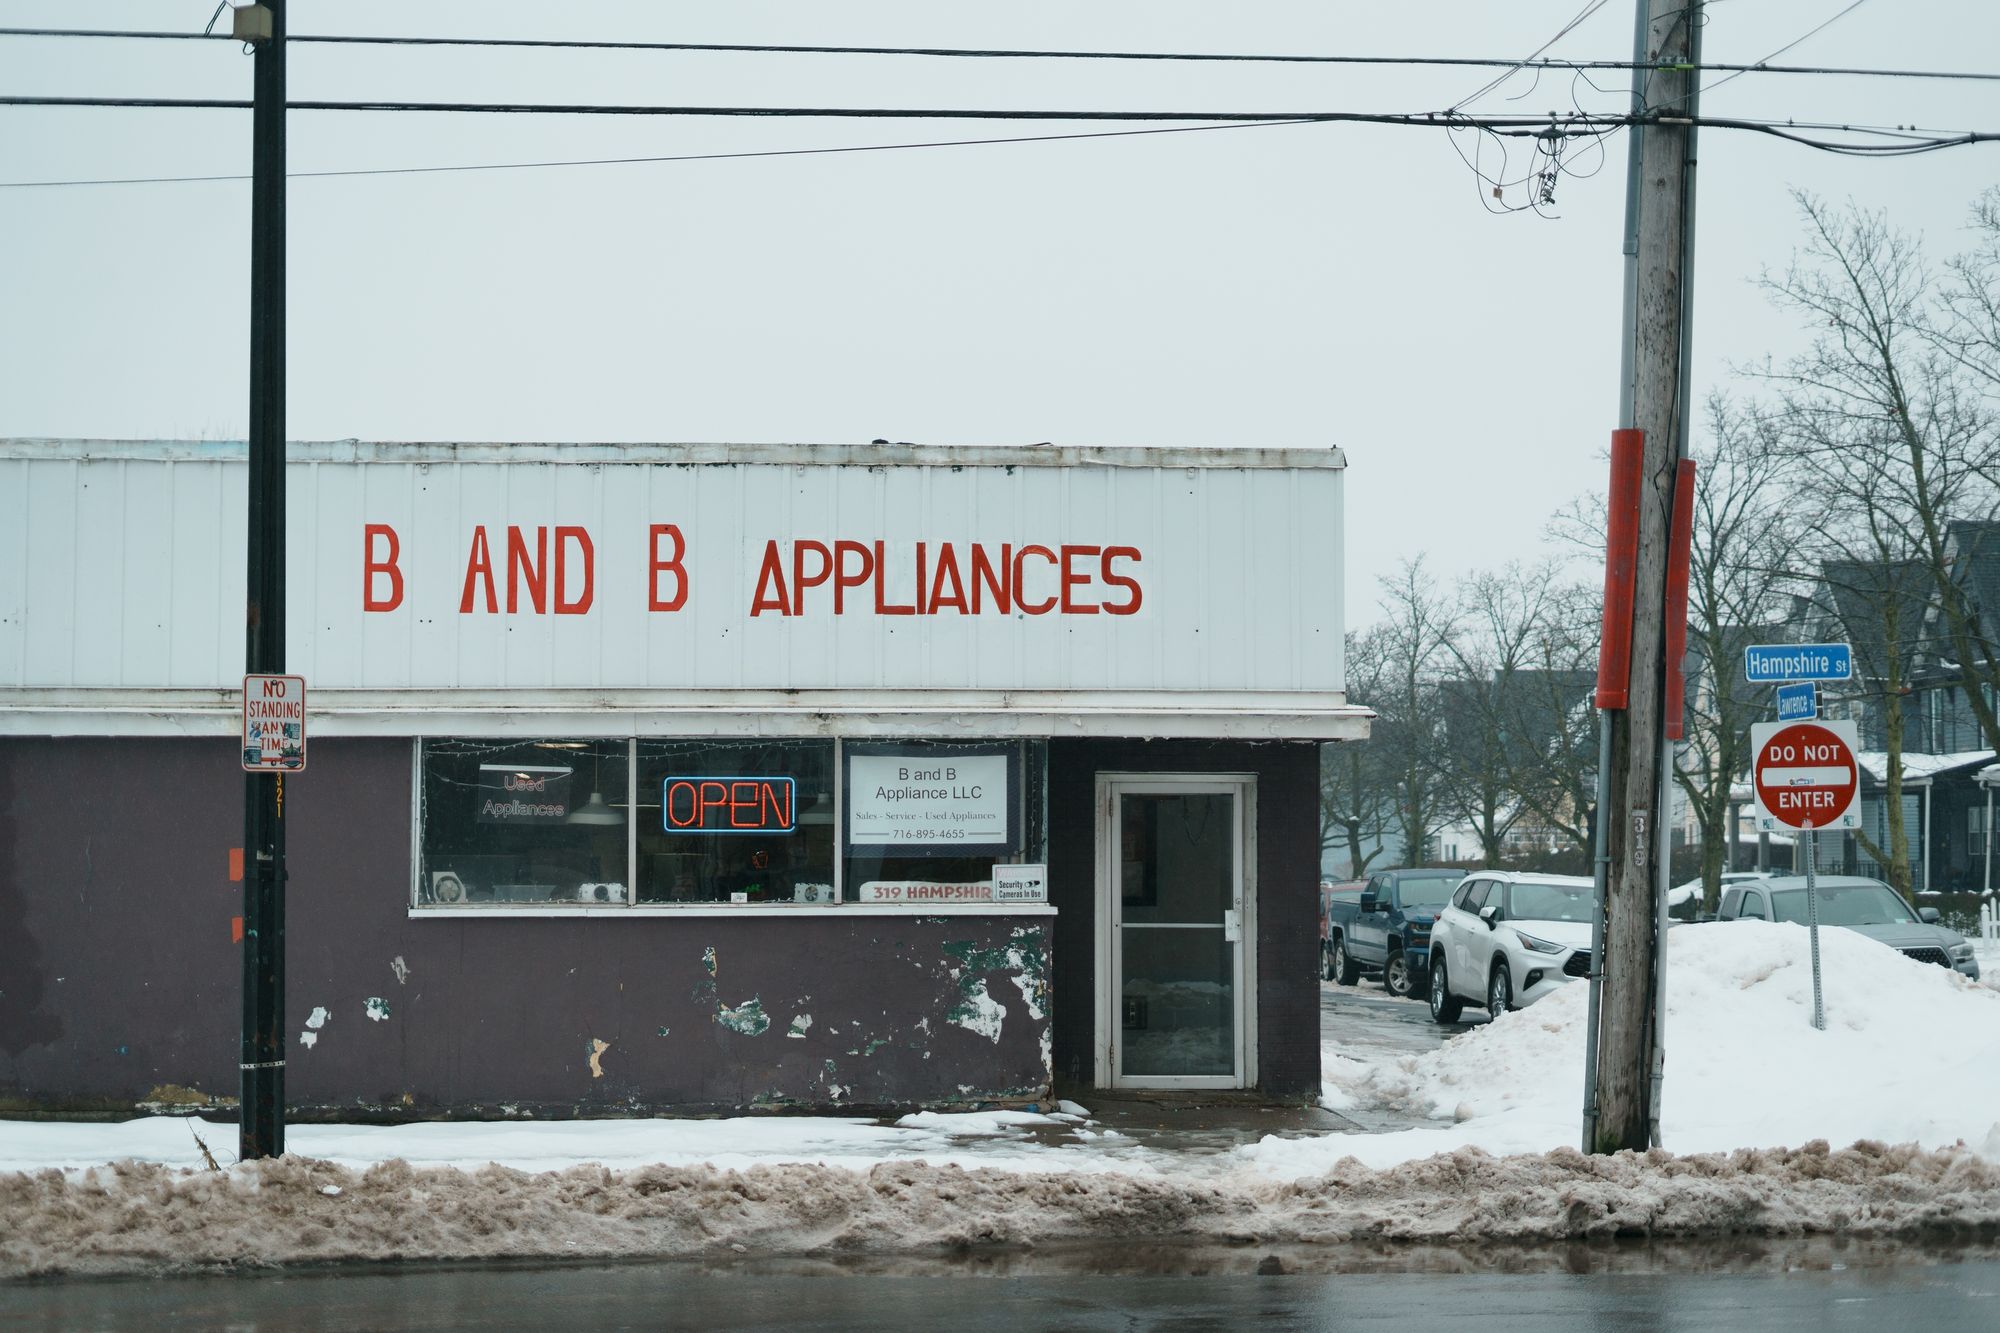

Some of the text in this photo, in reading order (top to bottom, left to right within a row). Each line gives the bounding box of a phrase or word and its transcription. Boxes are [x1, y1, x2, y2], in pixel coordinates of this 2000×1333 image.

[364, 524, 1143, 616] B AND B APPLIANCES
[1750, 651, 1847, 678] Hampshire St
[263, 680, 285, 698] NO
[249, 701, 300, 718] STANDING
[262, 722, 286, 734] ANY
[260, 738, 288, 751] TIME
[1770, 744, 1840, 762] DO NOT
[899, 768, 956, 781] B and B
[504, 775, 546, 792] Used
[875, 785, 983, 802] Appliance LLC
[1779, 792, 1835, 808] ENTER
[482, 799, 566, 819] Appliances
[669, 781, 790, 828] OPEN
[855, 811, 878, 821] Sales
[885, 811, 917, 821] Service
[925, 811, 948, 821] Used
[949, 811, 997, 823] Appliances
[893, 830, 965, 839] 716-895-4655
[1634, 817, 1645, 866] 319
[873, 887, 992, 899] 319 HAMPSHIR
[998, 880, 1024, 890] Security
[998, 890, 1042, 899] Cameras In Use
